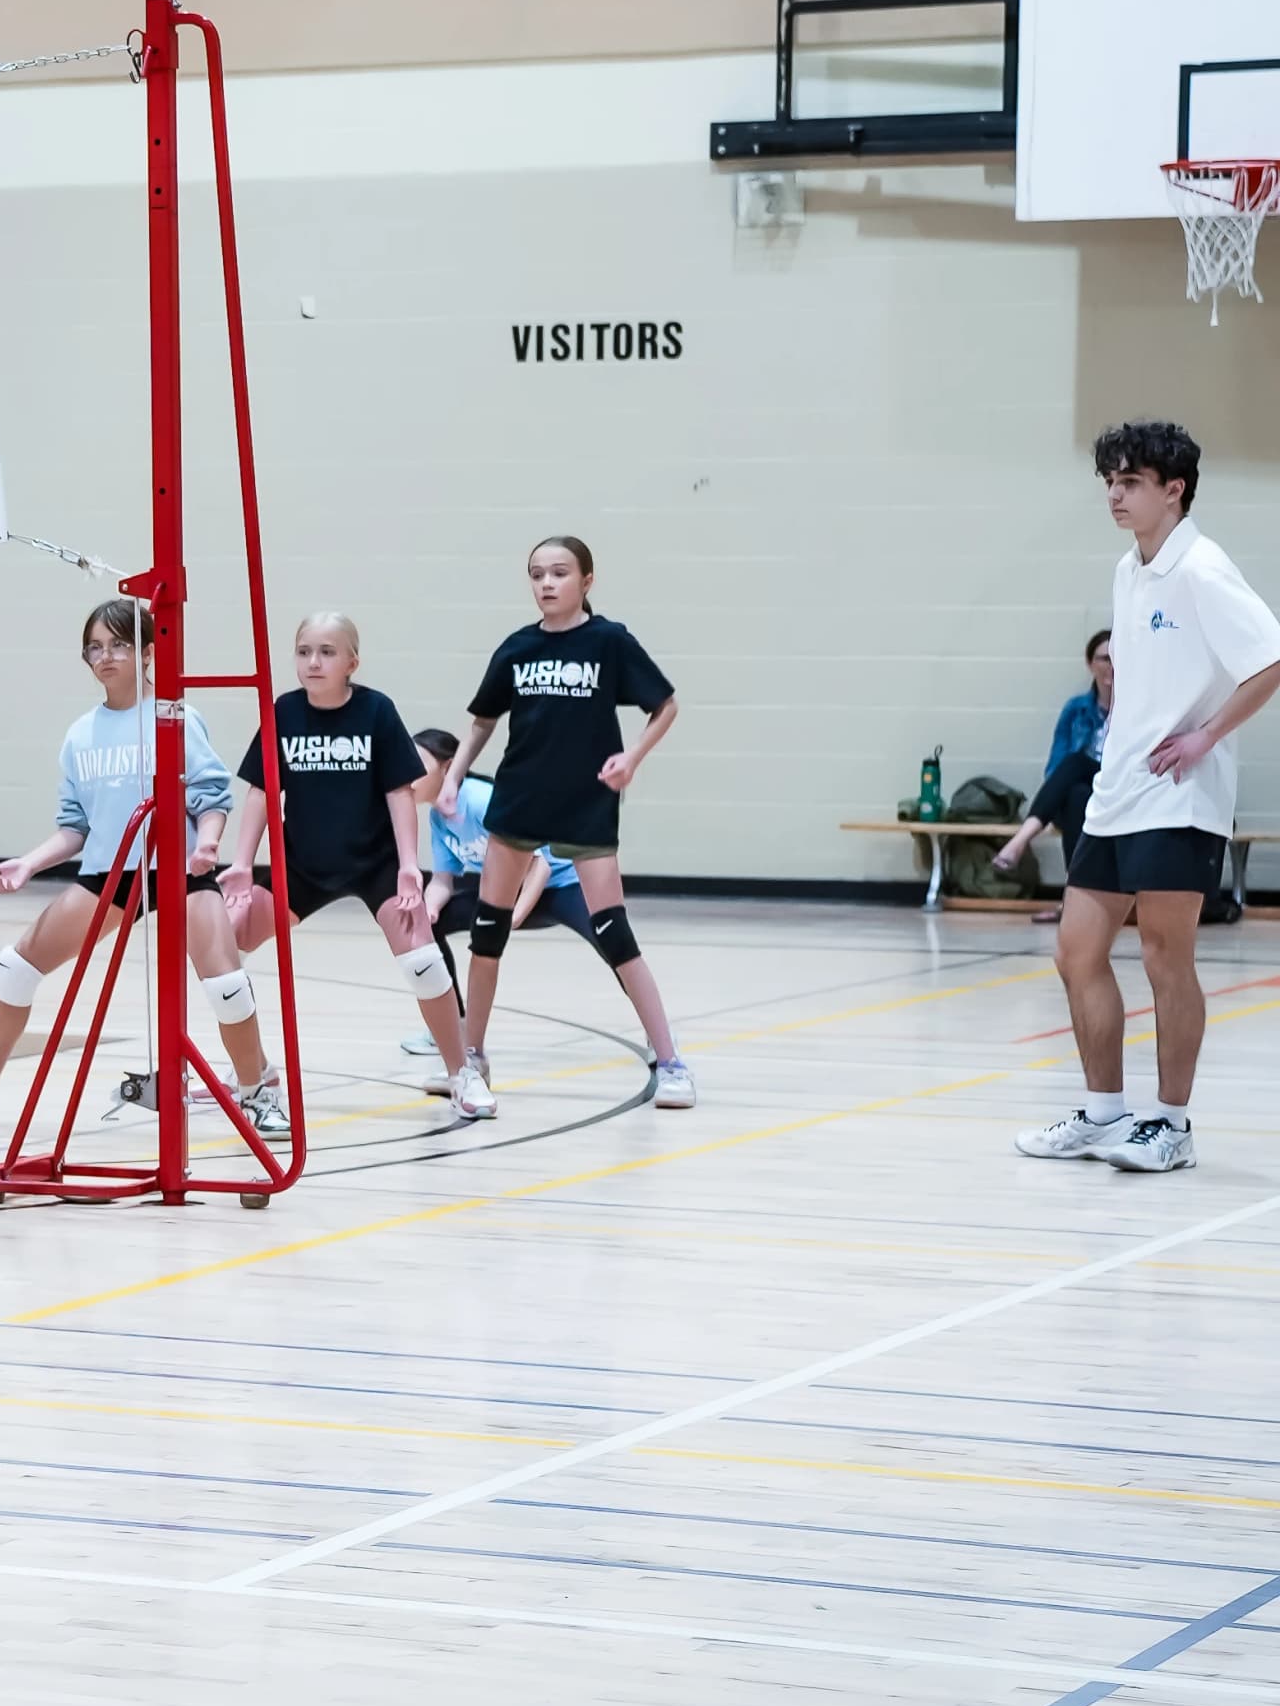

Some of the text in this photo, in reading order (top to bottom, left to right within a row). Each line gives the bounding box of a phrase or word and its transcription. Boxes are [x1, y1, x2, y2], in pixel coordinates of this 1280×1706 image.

[512, 321, 683, 362] VISITORS
[513, 660, 600, 688] VISION
[518, 686, 593, 697] VOLLEYBALL CLUB
[76, 744, 154, 782] HOLLISTE
[281, 735, 371, 763] VISION
[288, 761, 367, 771] VOLLEYBALL CLUB
